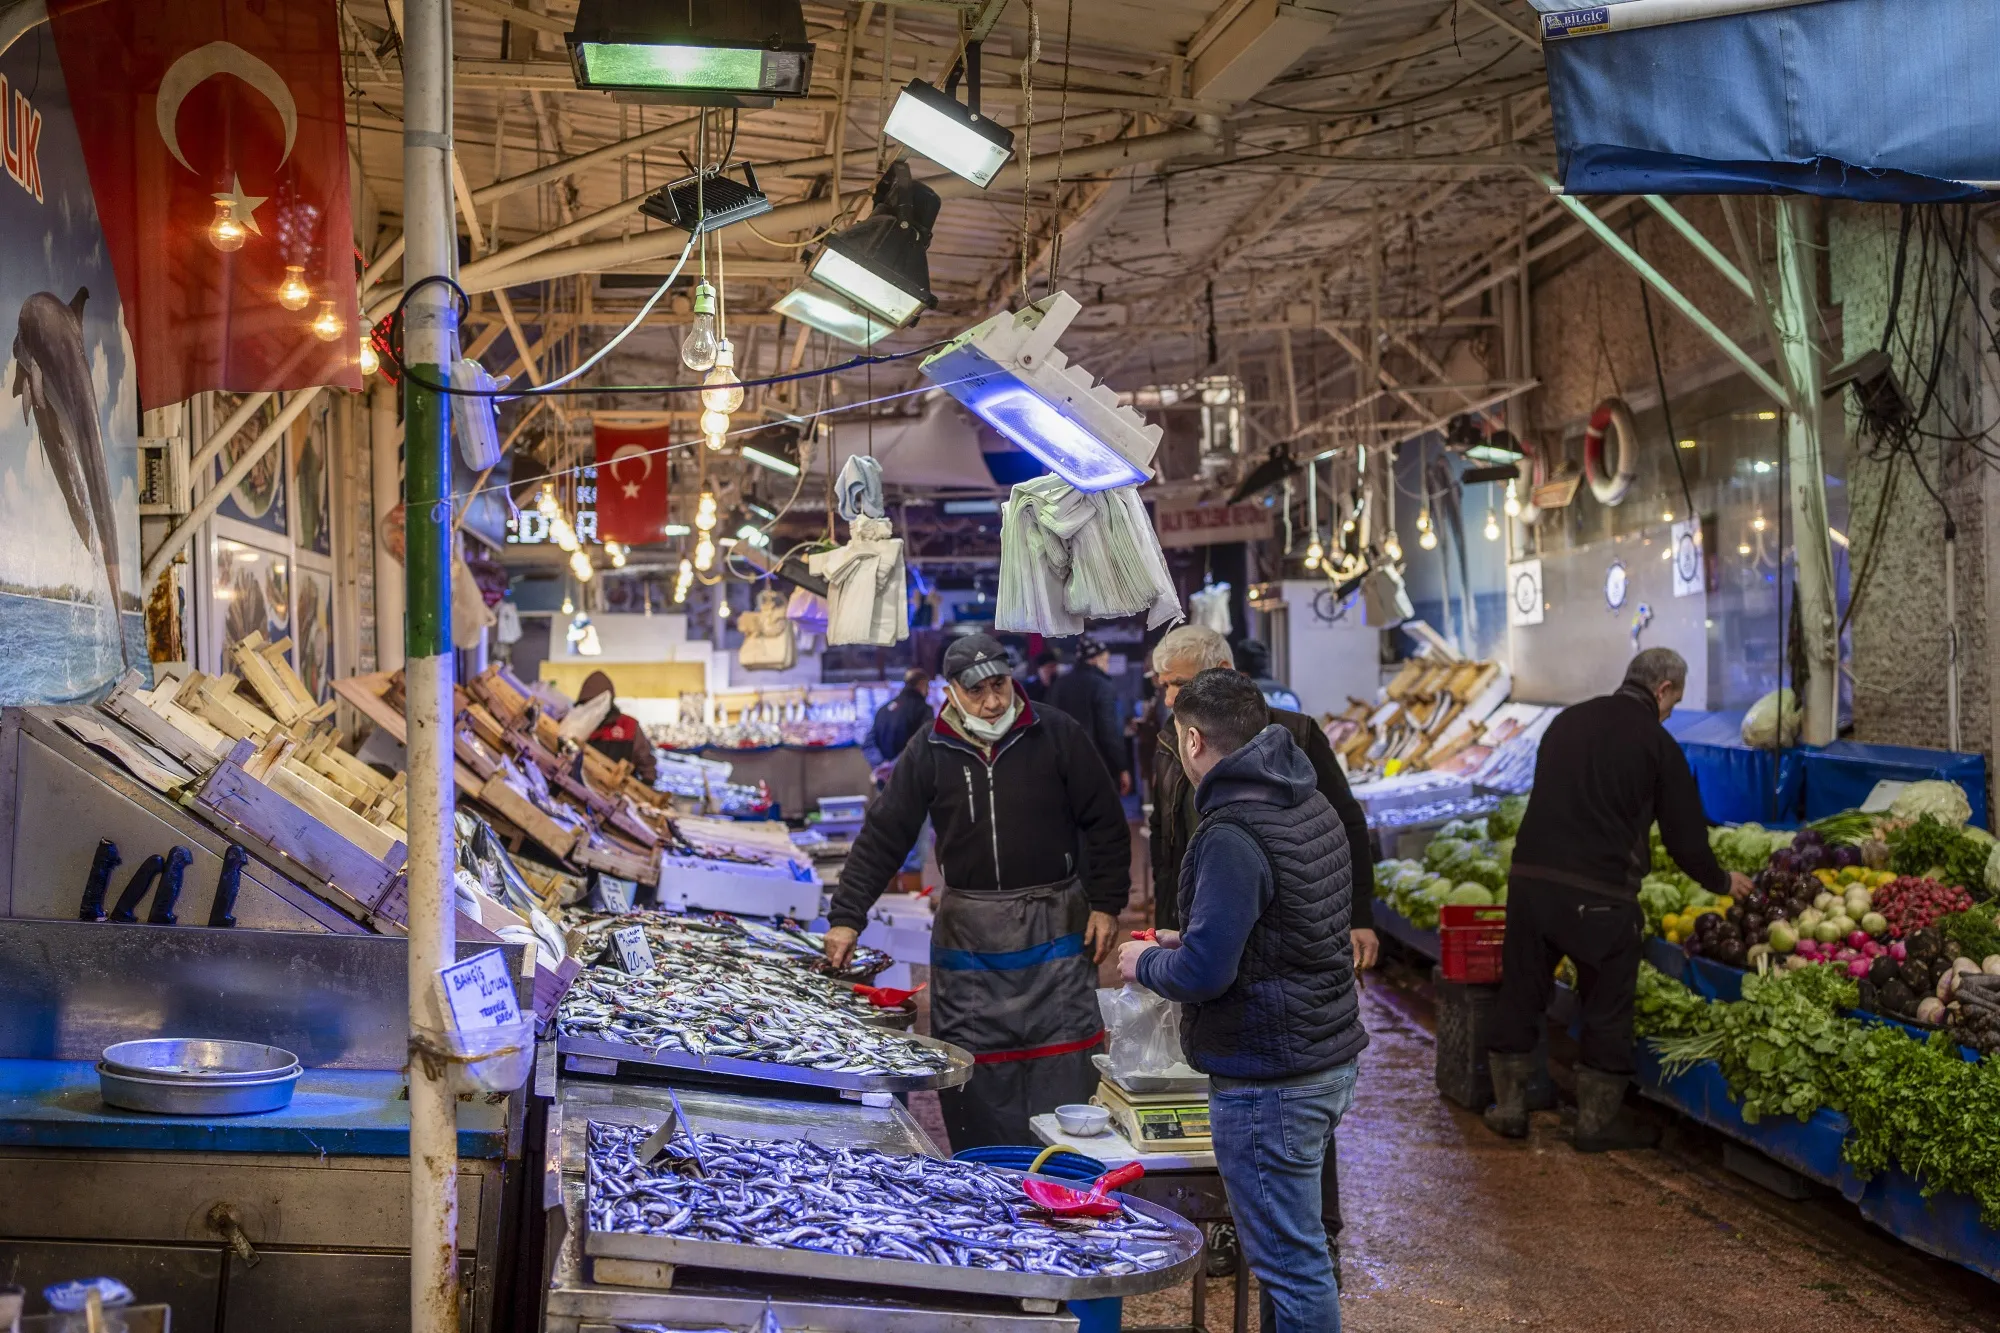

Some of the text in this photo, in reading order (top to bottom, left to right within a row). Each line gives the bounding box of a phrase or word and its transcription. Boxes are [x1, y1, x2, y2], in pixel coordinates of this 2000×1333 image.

[1564, 11, 1603, 25] BİLGİÇ
[0, 72, 43, 204] LIK
[627, 951, 640, 971] 20
